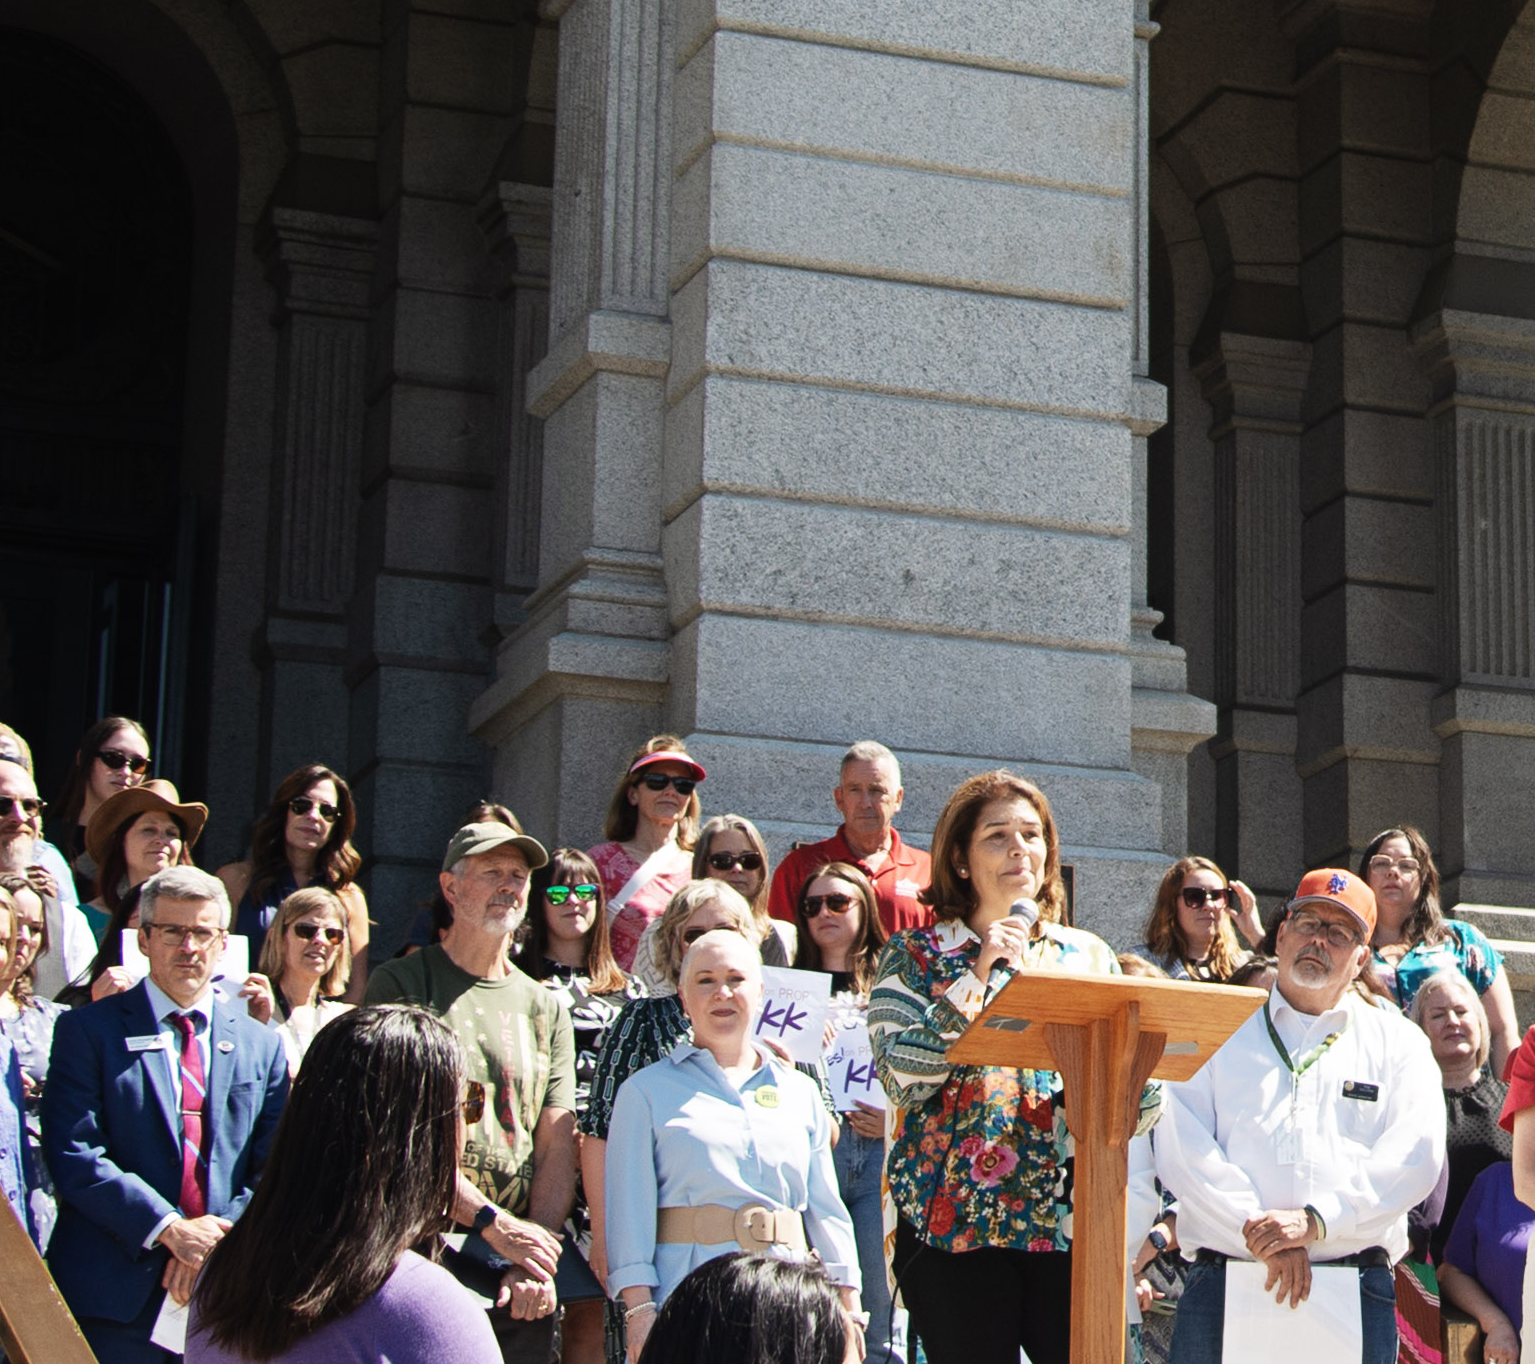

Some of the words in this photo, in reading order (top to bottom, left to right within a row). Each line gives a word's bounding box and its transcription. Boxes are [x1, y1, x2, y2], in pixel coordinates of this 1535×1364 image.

[778, 988, 809, 1001] PROP
[756, 999, 807, 1037] KK
[826, 1047, 844, 1066] ES!
